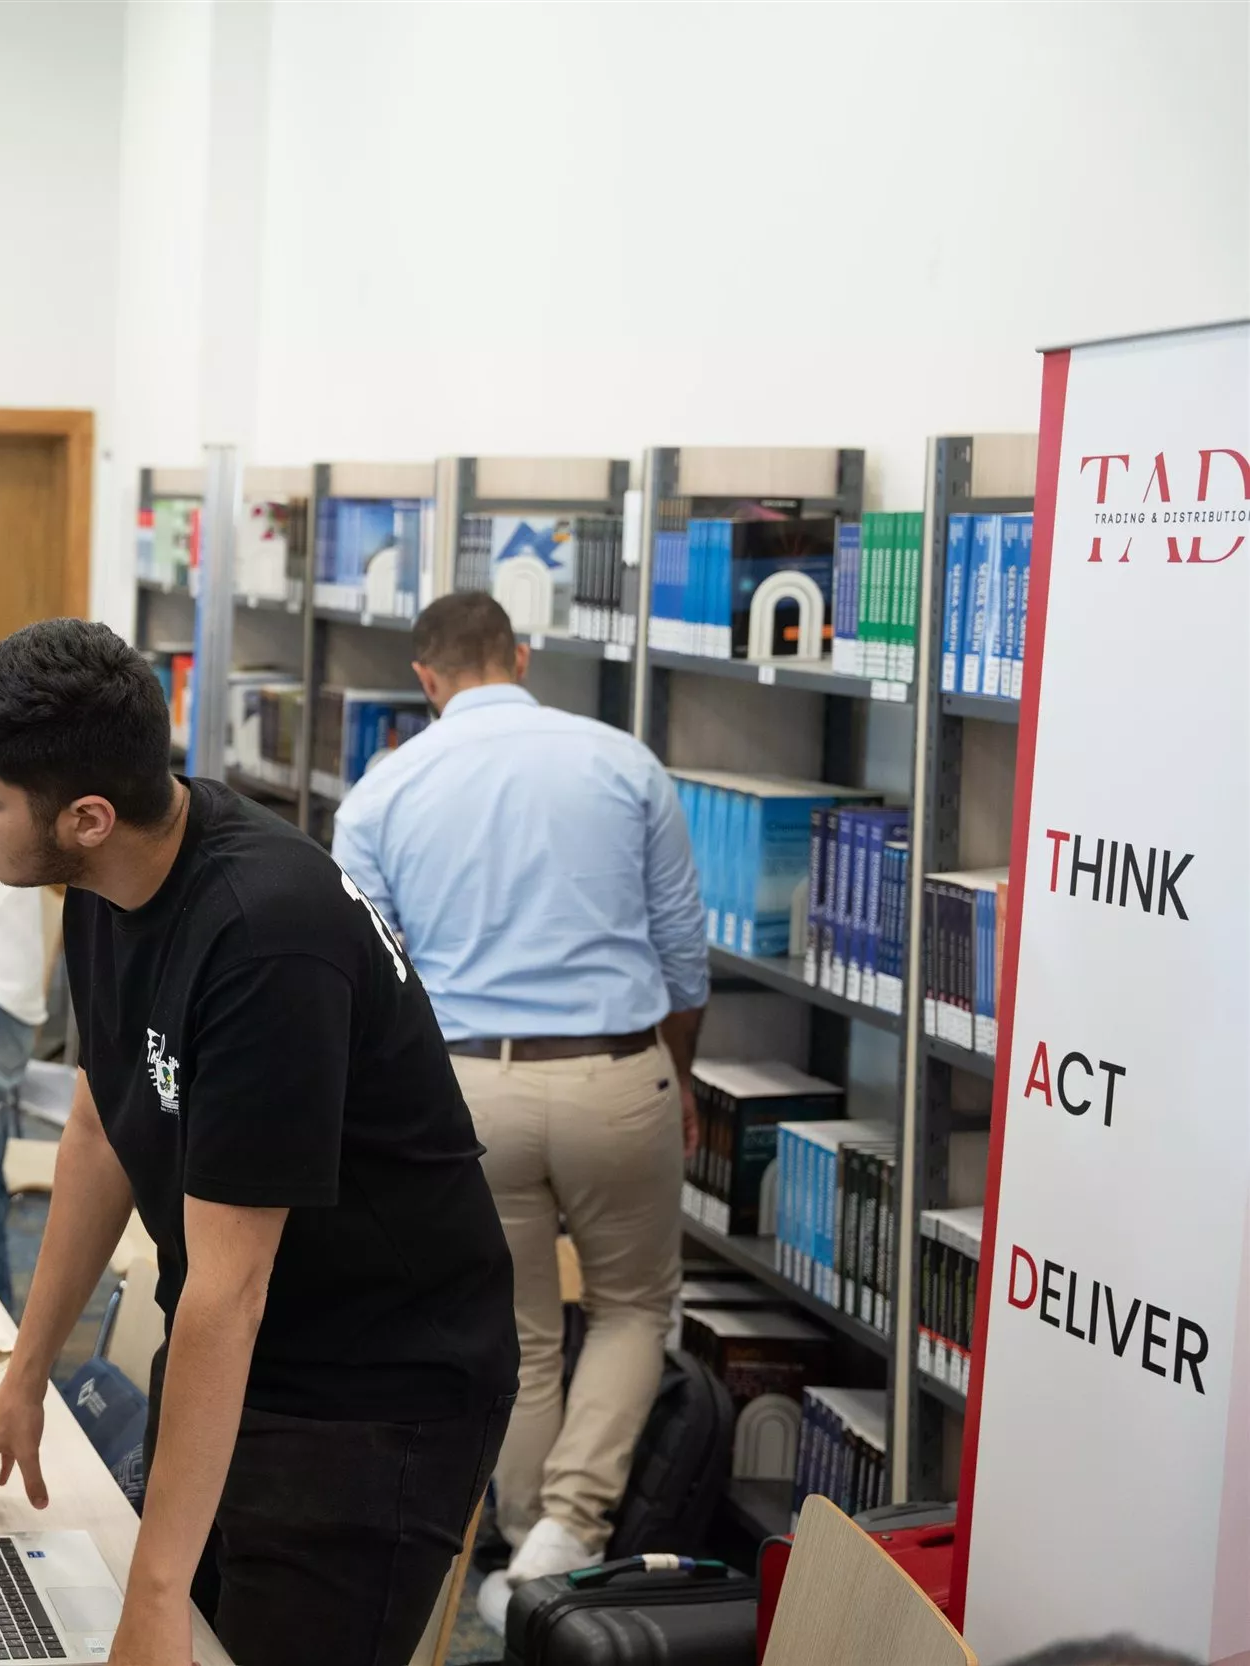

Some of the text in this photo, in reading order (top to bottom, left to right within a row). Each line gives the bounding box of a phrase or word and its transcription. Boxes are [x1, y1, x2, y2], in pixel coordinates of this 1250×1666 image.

[1080, 449, 1250, 563] TAD
[1094, 510, 1250, 524] TRADING & DISTRIBUTIO
[1046, 829, 1195, 921] THINK
[1024, 1040, 1126, 1127] ACT
[1007, 1244, 1209, 1395] DELIVER
